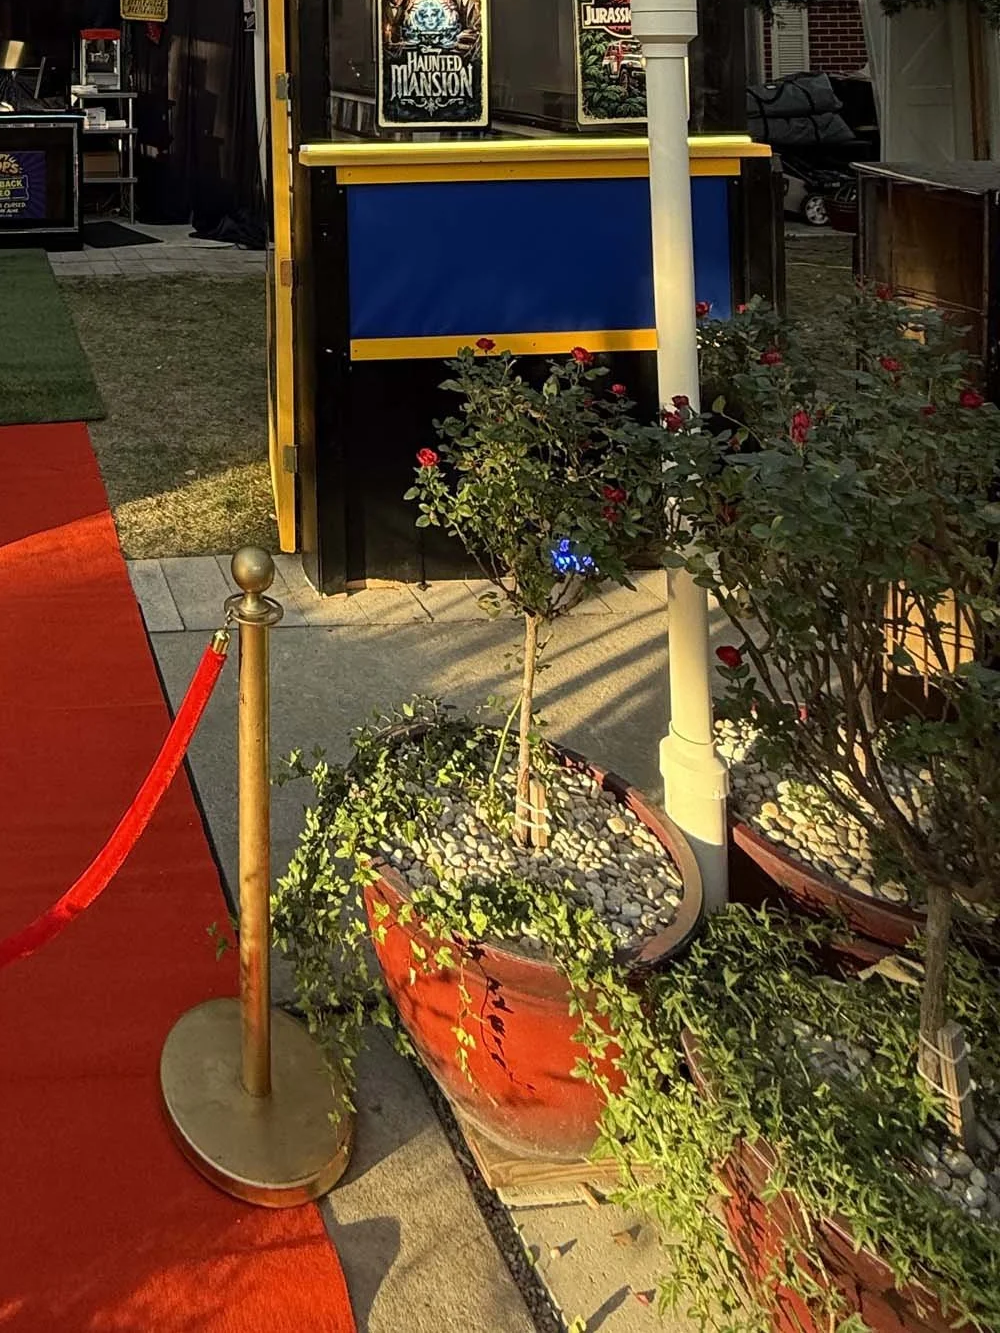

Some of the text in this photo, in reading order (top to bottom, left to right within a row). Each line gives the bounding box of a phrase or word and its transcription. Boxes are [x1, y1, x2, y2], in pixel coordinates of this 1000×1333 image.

[584, 6, 632, 26] JURASSI
[407, 51, 463, 78] HAUNTED
[391, 63, 474, 102] MANSION
